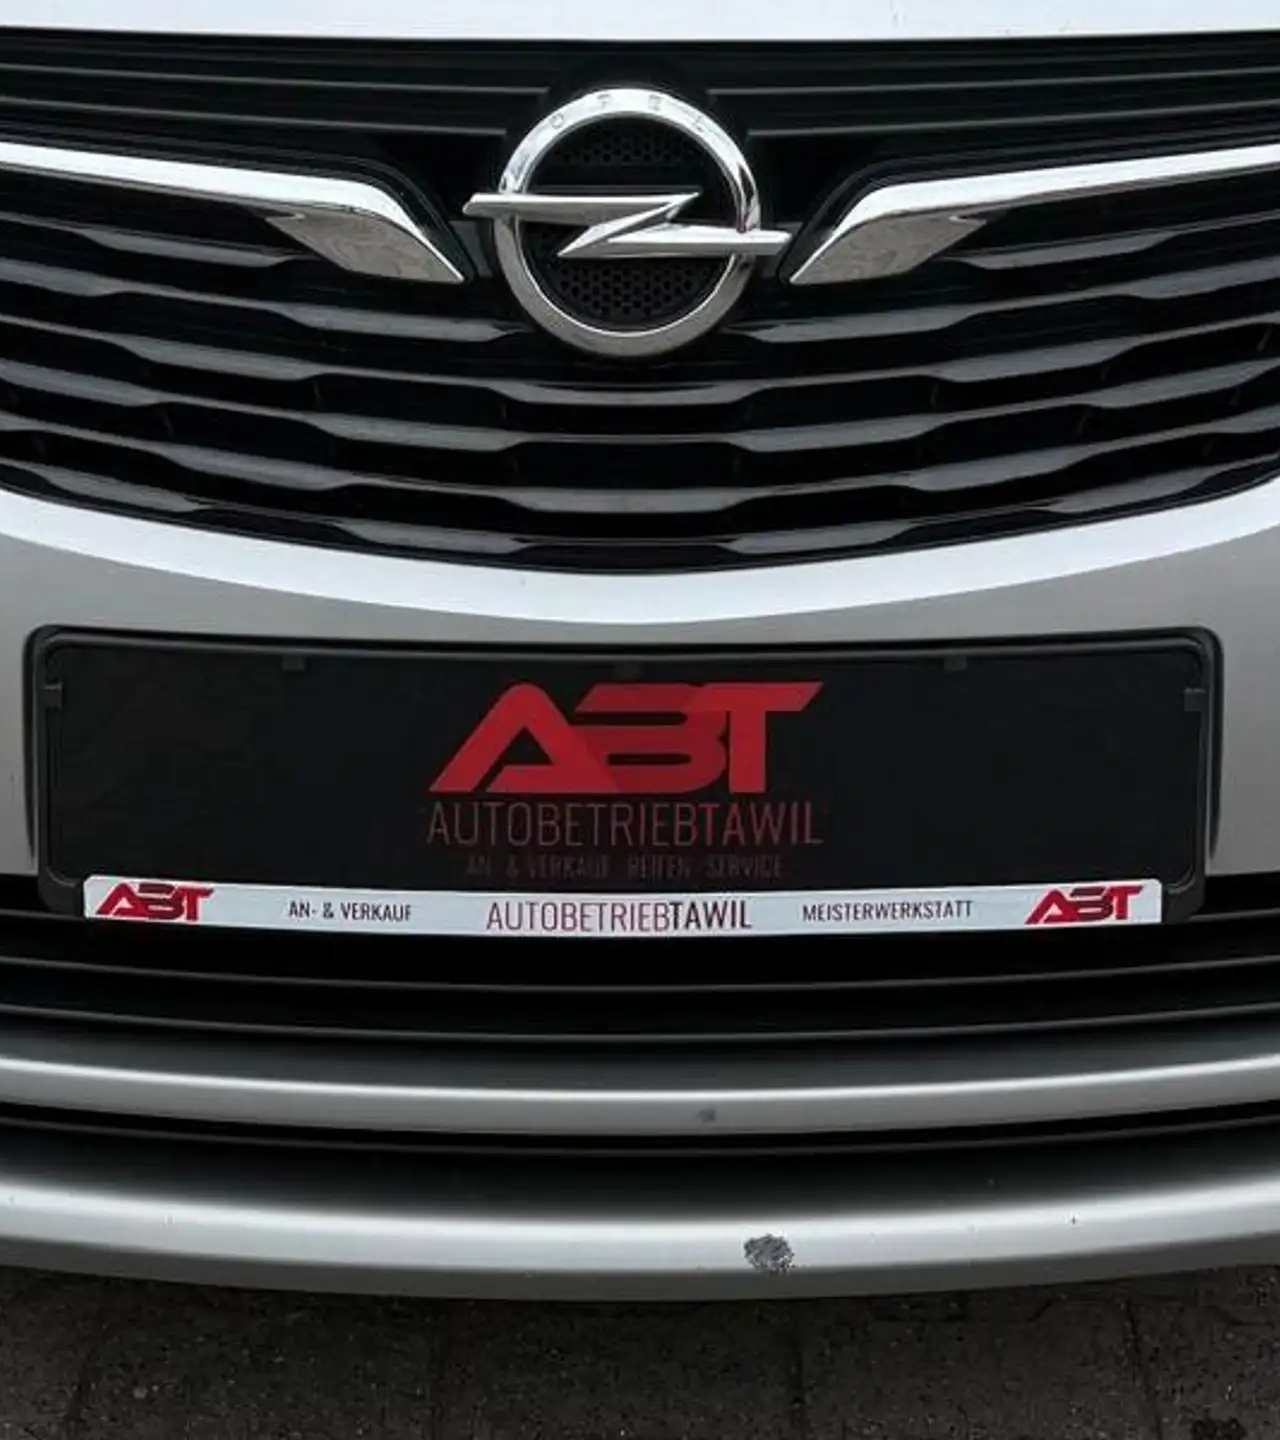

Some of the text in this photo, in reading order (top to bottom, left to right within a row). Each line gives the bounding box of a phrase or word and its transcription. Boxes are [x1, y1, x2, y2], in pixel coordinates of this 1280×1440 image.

[428, 680, 823, 794] ABT
[426, 800, 824, 848] AUTOBETRIEBTAWIL
[96, 882, 214, 922] ABT
[322, 902, 334, 920] &
[340, 901, 412, 923] VERKAUF
[486, 899, 753, 933] AUTOBETRIEBTAWIL
[802, 899, 974, 922] MEISTERWERKSTATT
[1024, 885, 1143, 926] ABT
